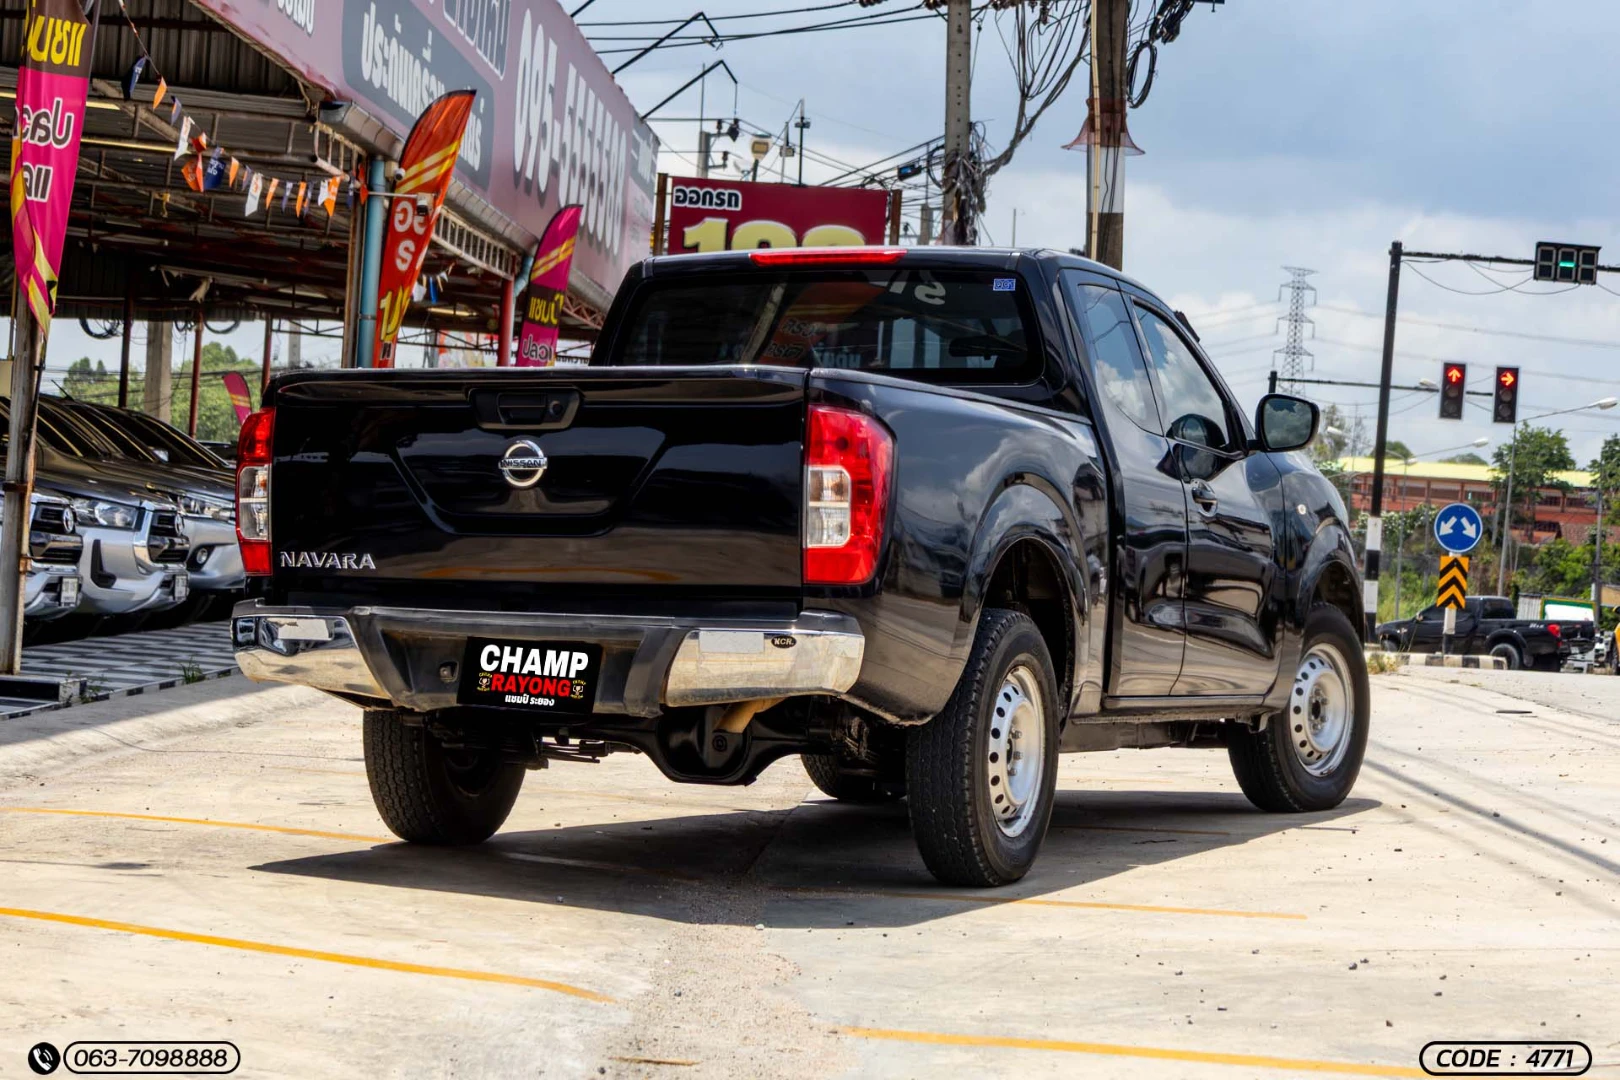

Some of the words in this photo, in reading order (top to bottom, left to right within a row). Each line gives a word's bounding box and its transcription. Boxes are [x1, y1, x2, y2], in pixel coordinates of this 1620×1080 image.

[513, 8, 627, 257] 095-5555588
[673, 187, 742, 211] ออกรถ
[500, 459, 542, 468] NISSAN
[279, 551, 377, 570] NAVARA
